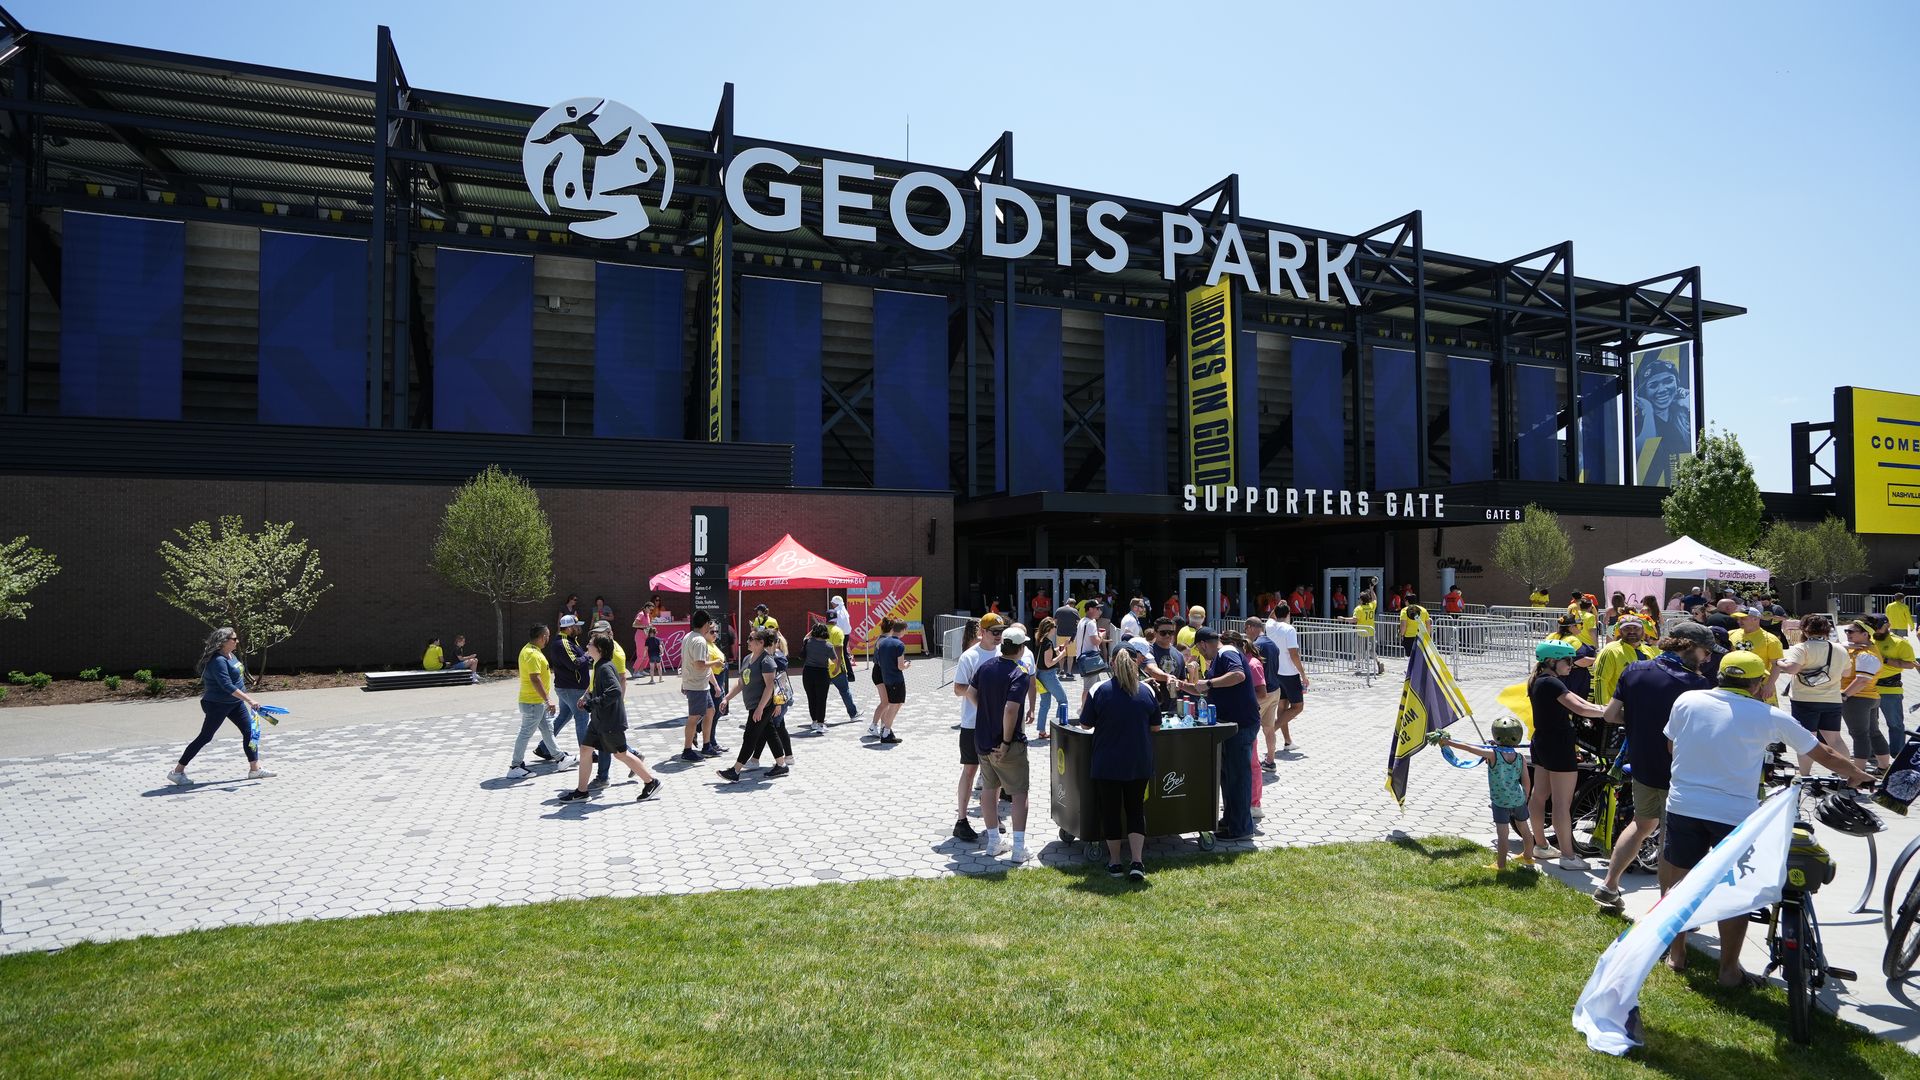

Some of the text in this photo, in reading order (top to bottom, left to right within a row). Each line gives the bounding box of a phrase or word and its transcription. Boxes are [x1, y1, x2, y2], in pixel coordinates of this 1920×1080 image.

[725, 147, 1362, 306] GEODIS PARK
[1191, 302, 1230, 487] BOYS IN GOLD
[1871, 435, 1920, 452] COME
[1184, 484, 1444, 517] SUPPORTERS GATE
[1486, 509, 1521, 520] GATE B
[695, 515, 708, 556] B
[773, 550, 817, 574] Bev
[1719, 570, 1757, 580] braidbabes
[854, 615, 876, 640] BEV
[872, 591, 901, 619] WINE
[895, 592, 920, 617] WIN
[1365, 610, 1374, 620] 10
[1163, 771, 1185, 793] Bev
